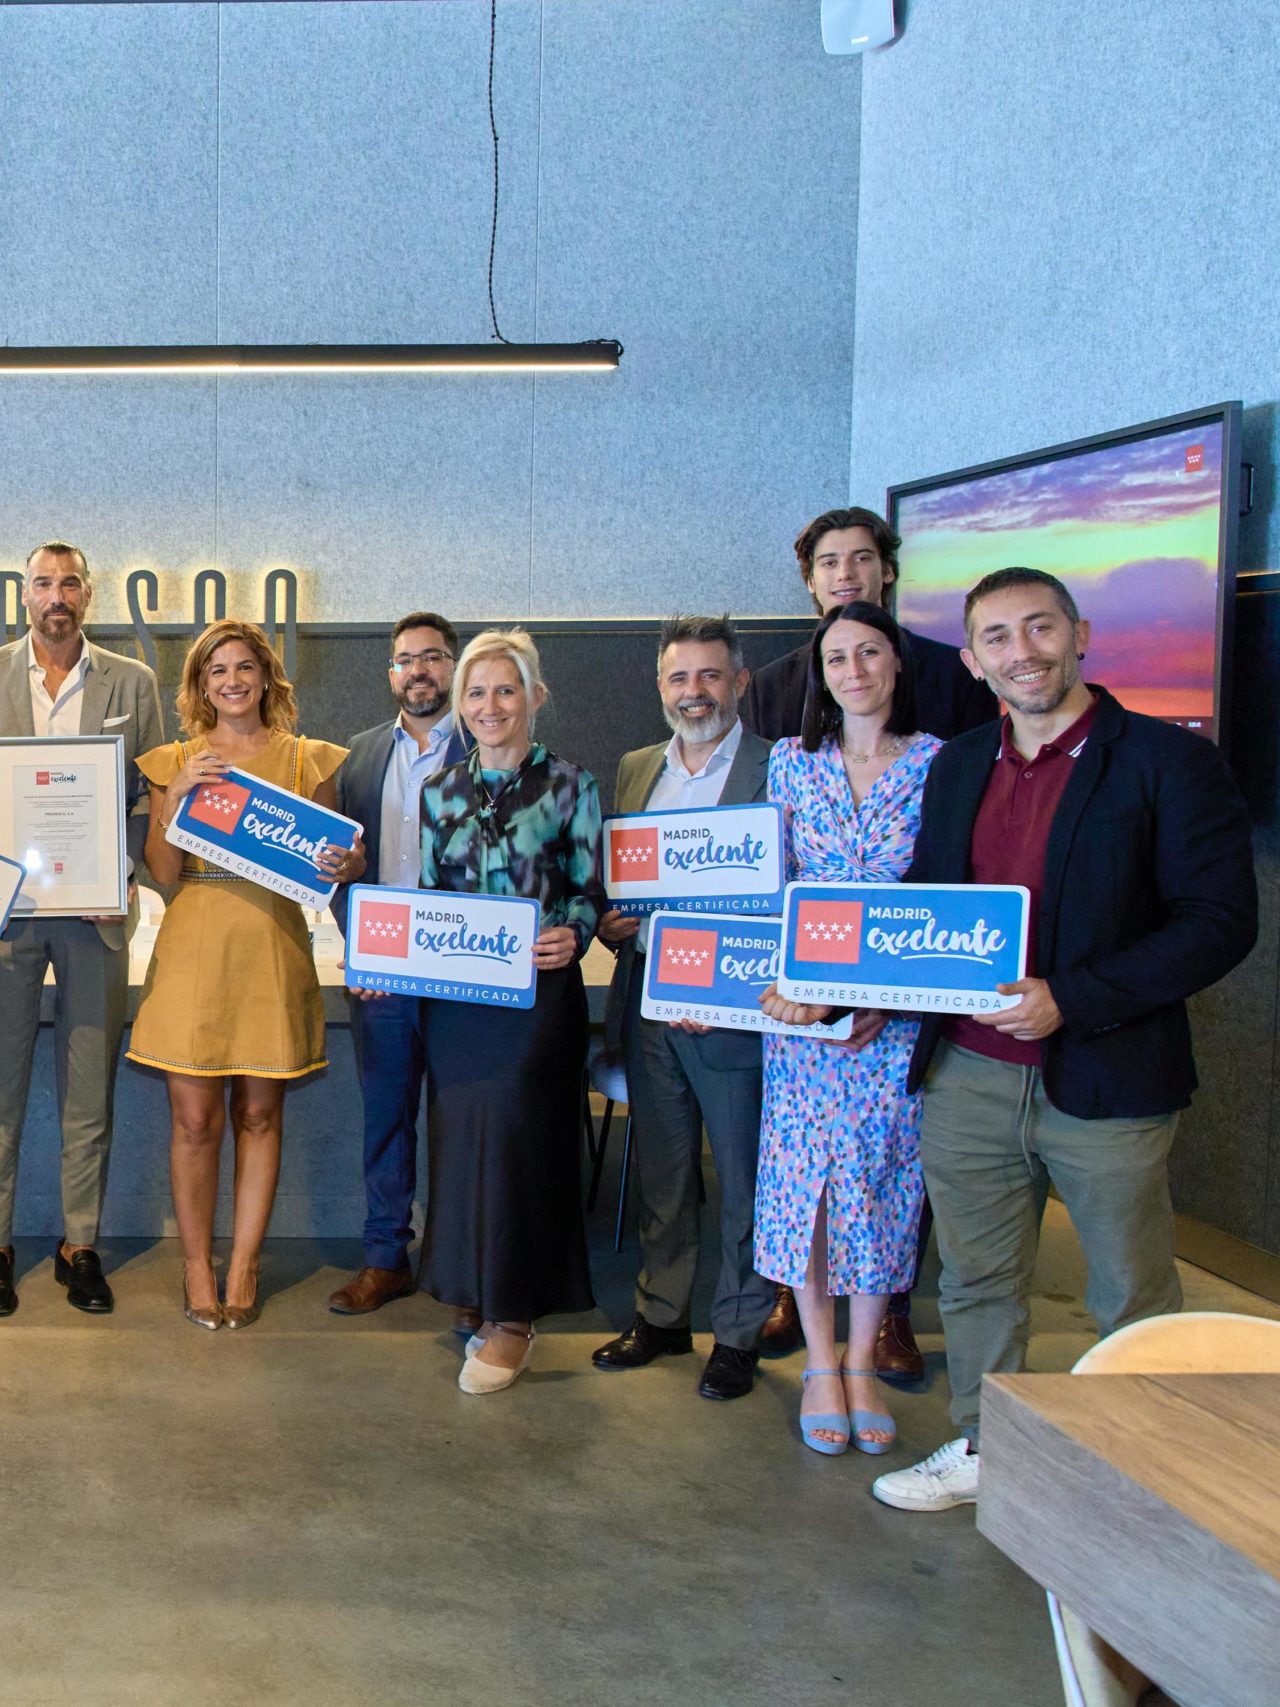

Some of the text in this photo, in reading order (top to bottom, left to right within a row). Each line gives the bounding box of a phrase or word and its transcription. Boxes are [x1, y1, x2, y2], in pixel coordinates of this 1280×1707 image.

[252, 797, 295, 823] MADRID
[663, 828, 710, 840] MADRID
[664, 833, 767, 870] excelente
[177, 835, 316, 904] EMPRESA CERTIFICADA
[677, 900, 770, 911] CERTIFICADA
[868, 907, 932, 920] MADRID
[415, 910, 464, 924] MADRID
[414, 922, 521, 957] excelente
[722, 936, 777, 950] MADRID
[867, 917, 1006, 956] excelente
[357, 975, 520, 1002] EMPRESA CERTIFICADA
[793, 987, 1002, 1009] EMPRESA CERTIFICADA
[655, 1006, 721, 1021] EMPRESA
